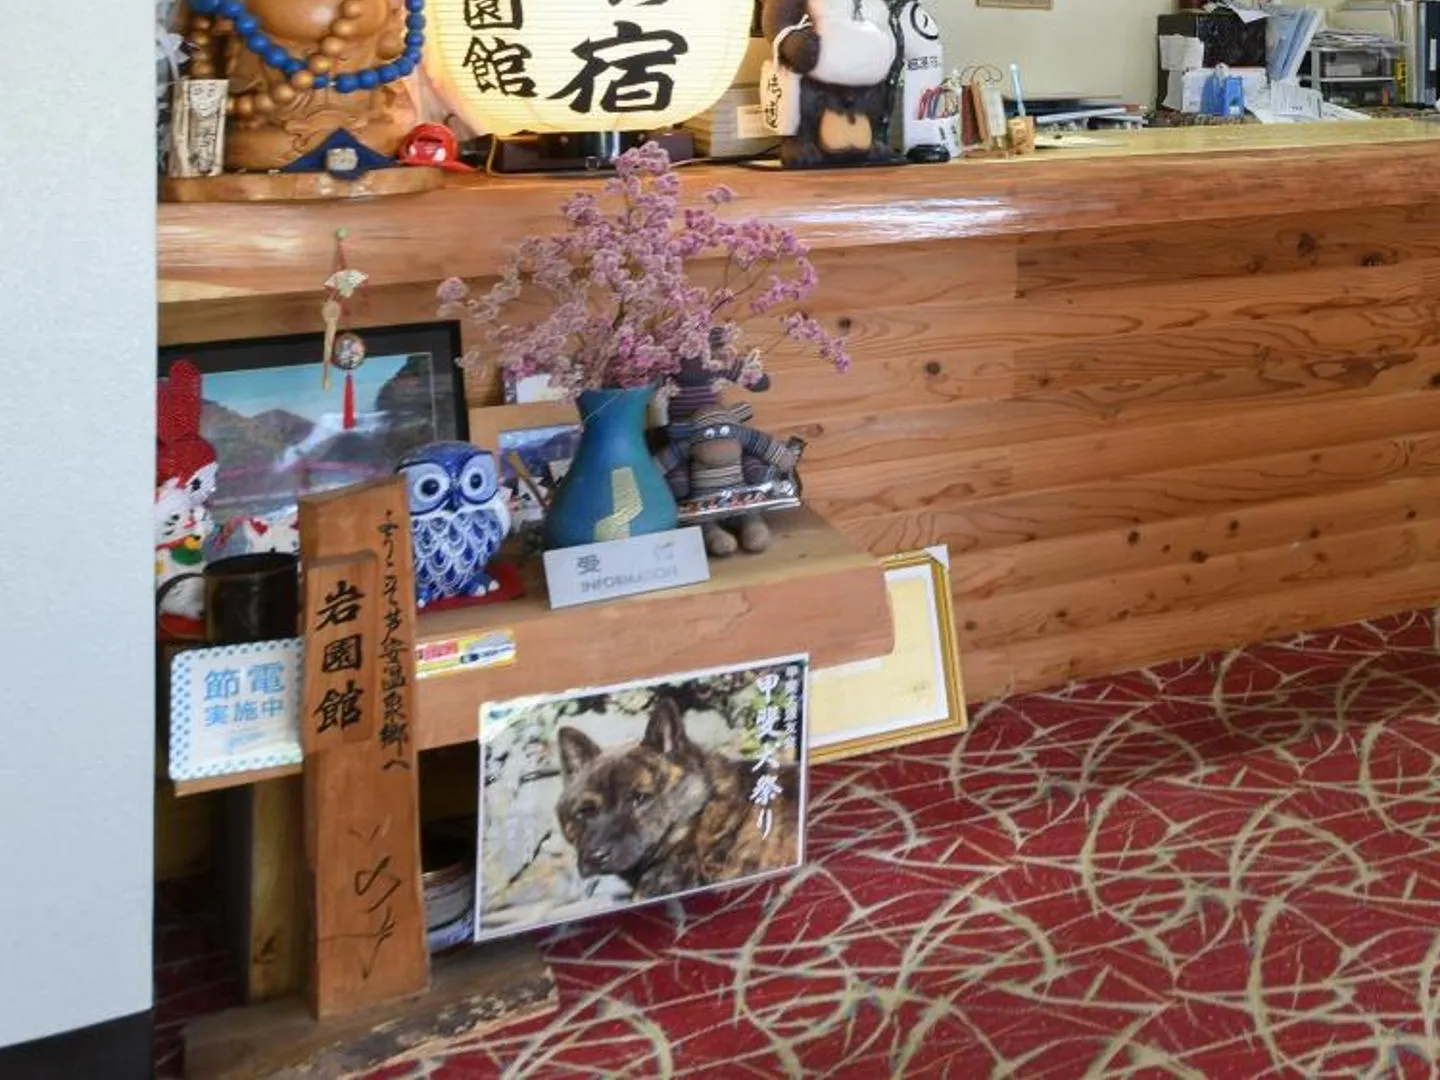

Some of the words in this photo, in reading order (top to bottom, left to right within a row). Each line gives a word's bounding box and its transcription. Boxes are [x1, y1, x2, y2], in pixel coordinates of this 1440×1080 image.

[314, 579, 366, 734] 岩園館
[203, 661, 285, 701] 節電
[204, 697, 285, 728] 実施中
